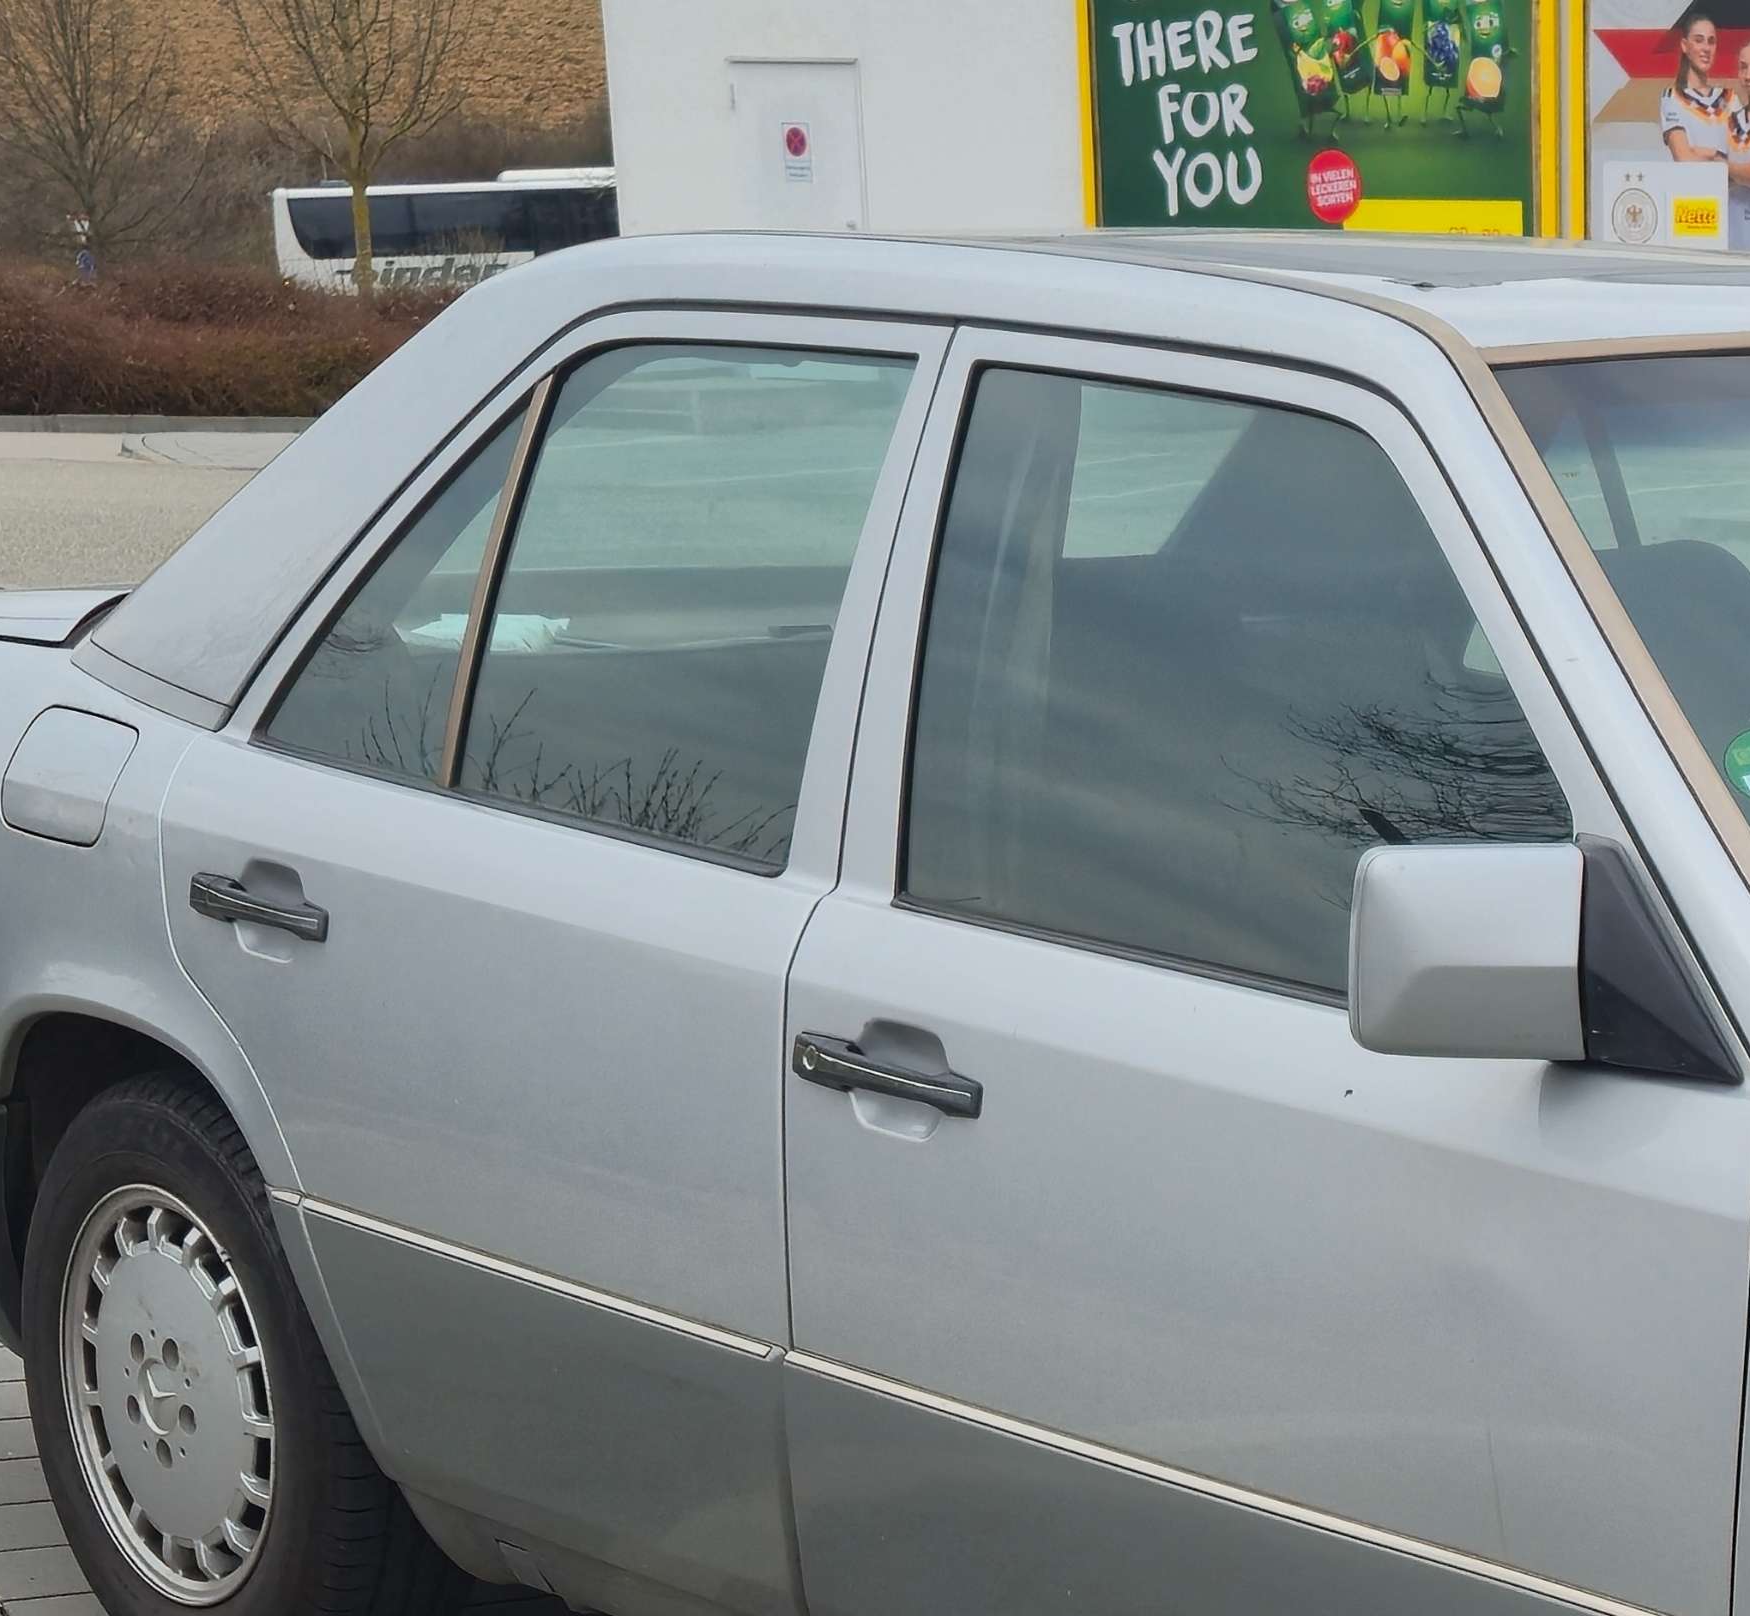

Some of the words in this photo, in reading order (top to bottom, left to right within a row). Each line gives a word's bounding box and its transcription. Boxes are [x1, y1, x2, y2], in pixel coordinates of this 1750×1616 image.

[1112, 10, 1258, 87] THERE
[1158, 83, 1254, 144] FOR
[1153, 147, 1263, 216] YOU
